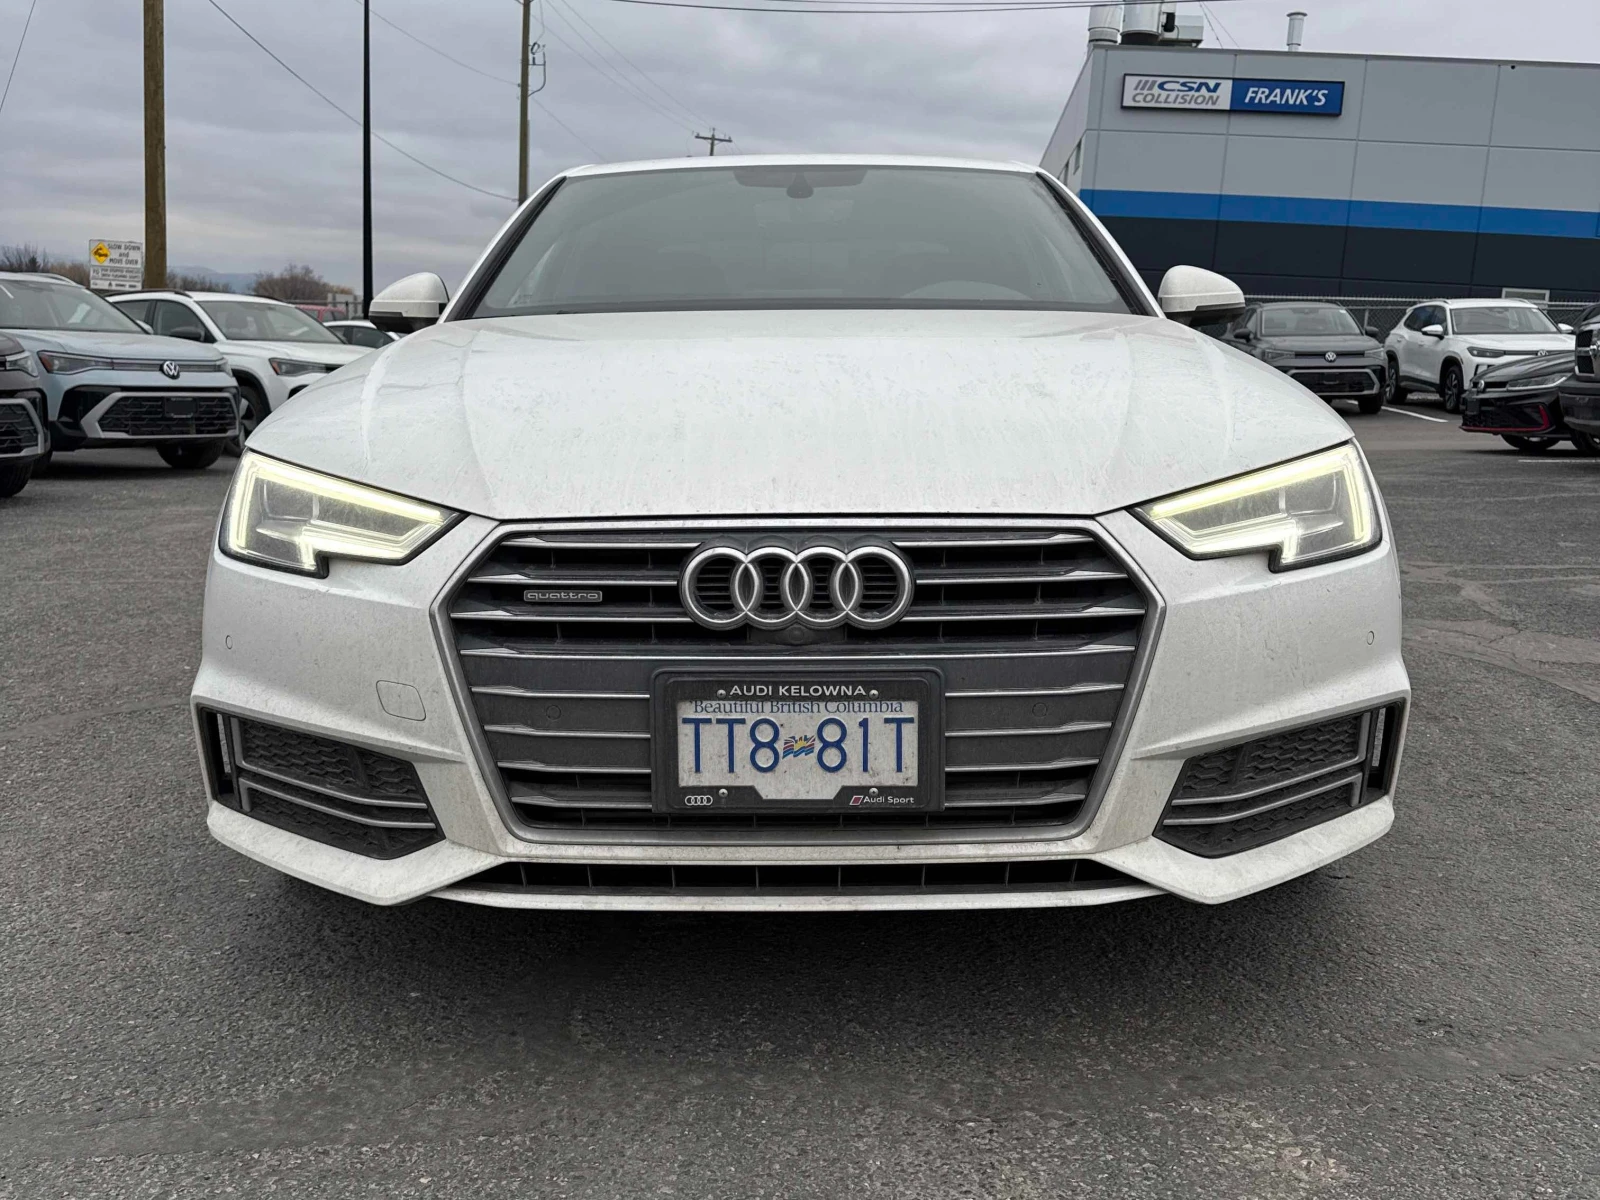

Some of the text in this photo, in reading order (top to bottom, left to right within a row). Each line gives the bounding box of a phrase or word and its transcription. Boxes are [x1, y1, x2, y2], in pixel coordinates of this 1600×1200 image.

[1157, 80, 1221, 93] CSN
[1132, 92, 1220, 106] COLLISION
[1244, 87, 1328, 106] FRANK'S
[527, 592, 598, 600] quattro
[729, 685, 867, 696] AUDI KELOWNA
[694, 701, 904, 713] Beautiful British Columbia
[682, 717, 915, 773] TT8 81T
[887, 796, 915, 805] Sport
